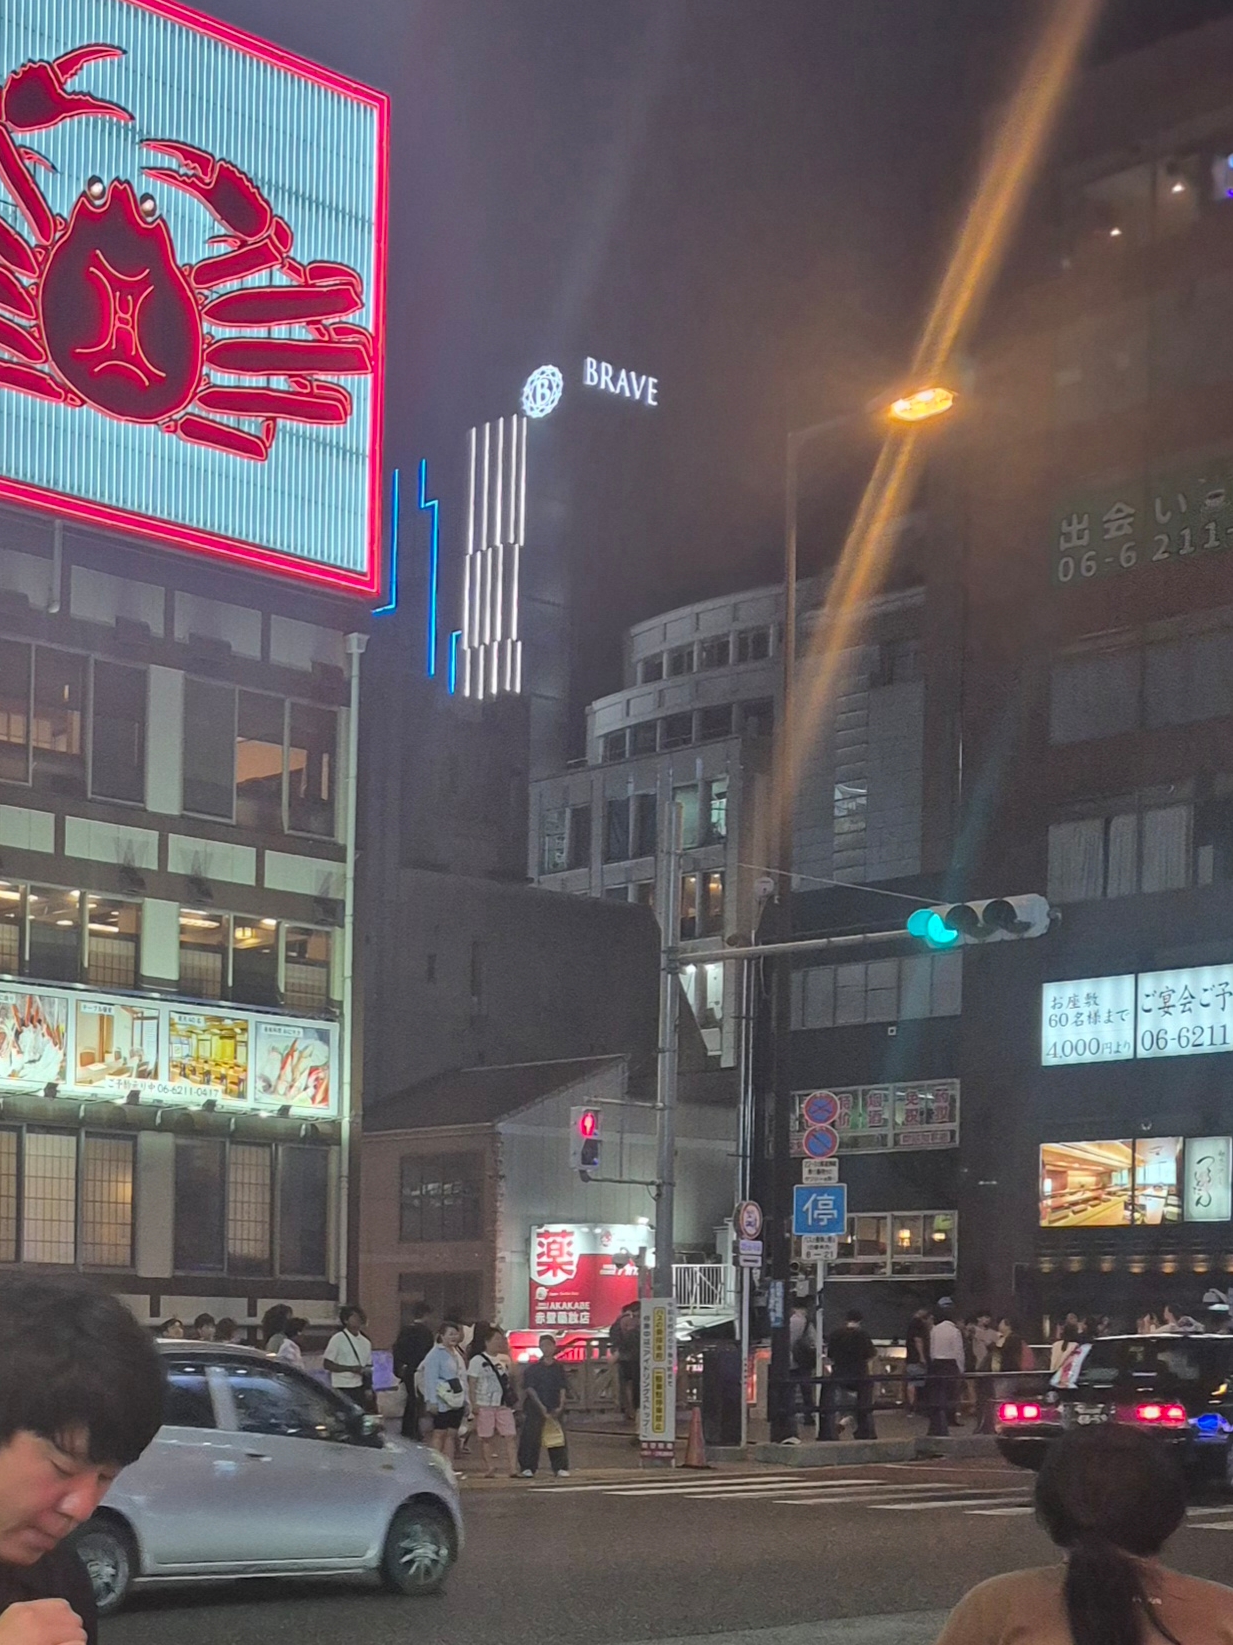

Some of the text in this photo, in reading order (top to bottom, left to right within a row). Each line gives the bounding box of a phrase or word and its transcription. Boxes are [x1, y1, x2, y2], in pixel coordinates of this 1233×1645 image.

[583, 356, 659, 406] BRAVE
[1050, 992, 1101, 1011] お座敷
[1141, 981, 1233, 1018] ご宴会ご予
[1048, 1008, 1130, 1029] 60名様まで
[1141, 1023, 1231, 1053] 06-6211
[802, 1193, 838, 1226] 停
[536, 1229, 575, 1278] 薬
